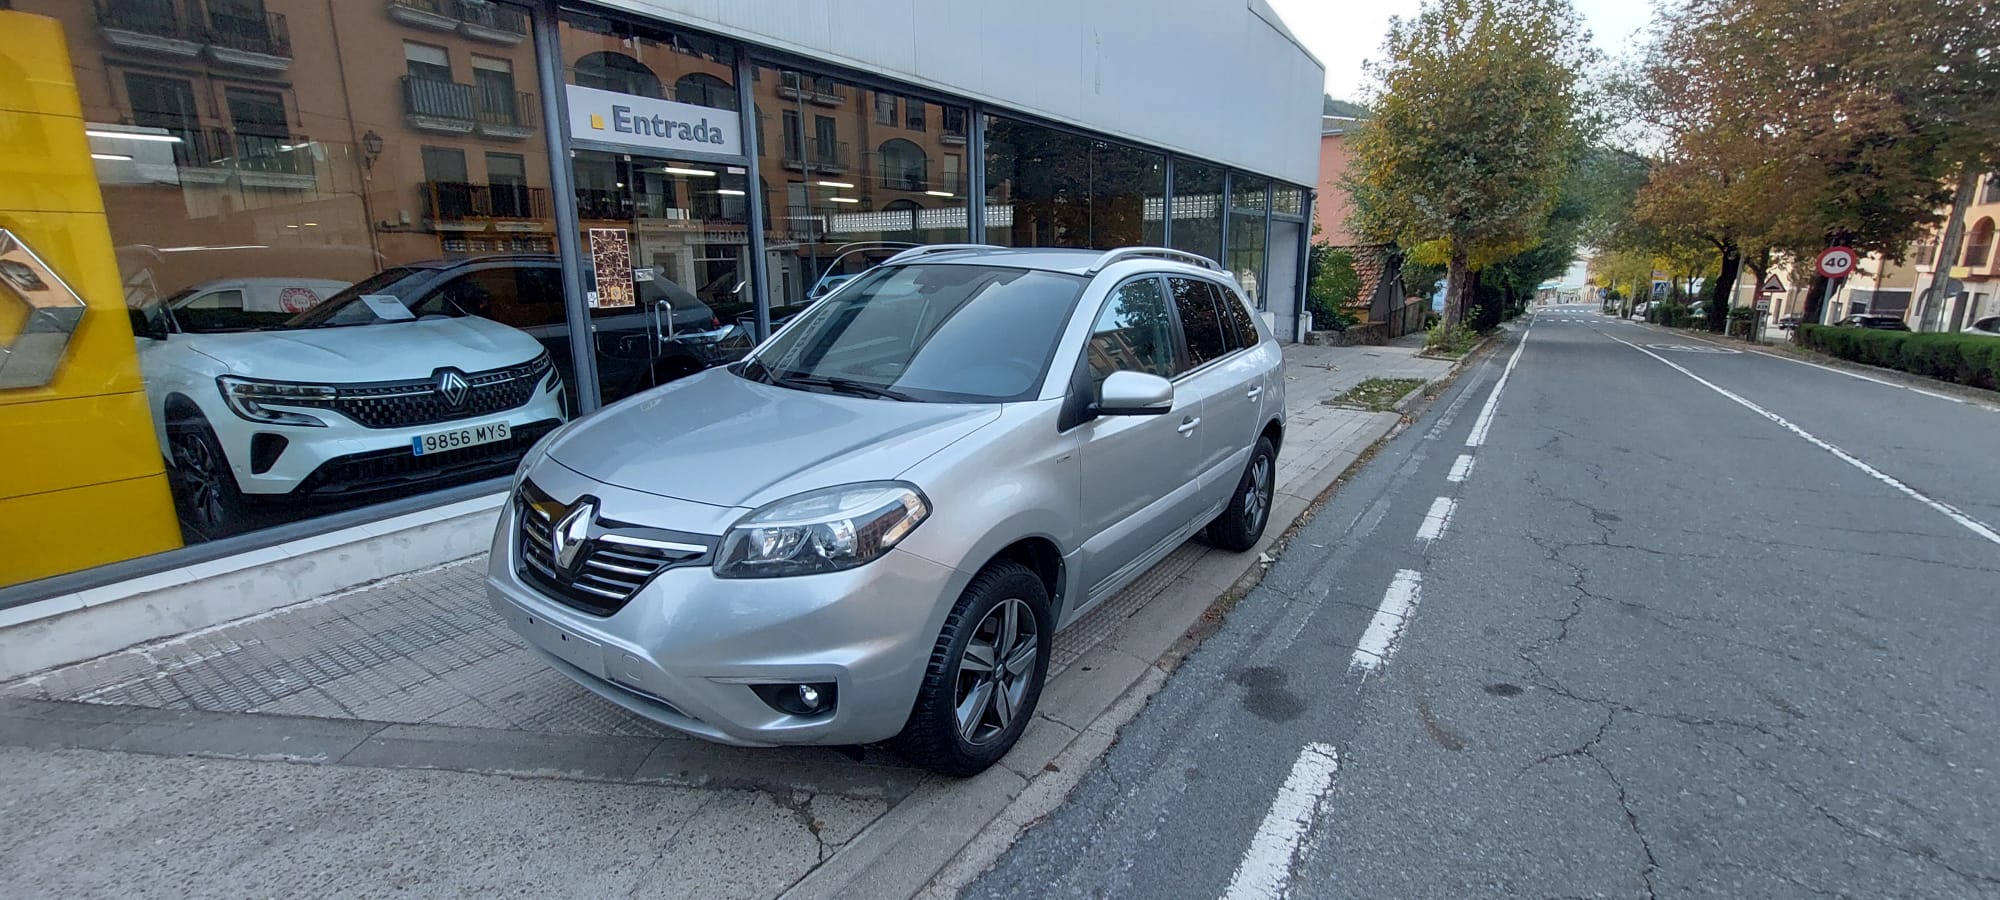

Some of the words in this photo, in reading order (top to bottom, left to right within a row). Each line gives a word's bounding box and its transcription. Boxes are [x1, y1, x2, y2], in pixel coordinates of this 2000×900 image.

[612, 104, 724, 144] Entrada
[1824, 257, 1848, 268] 40
[426, 430, 471, 451] 9856
[476, 424, 507, 442] MYS
